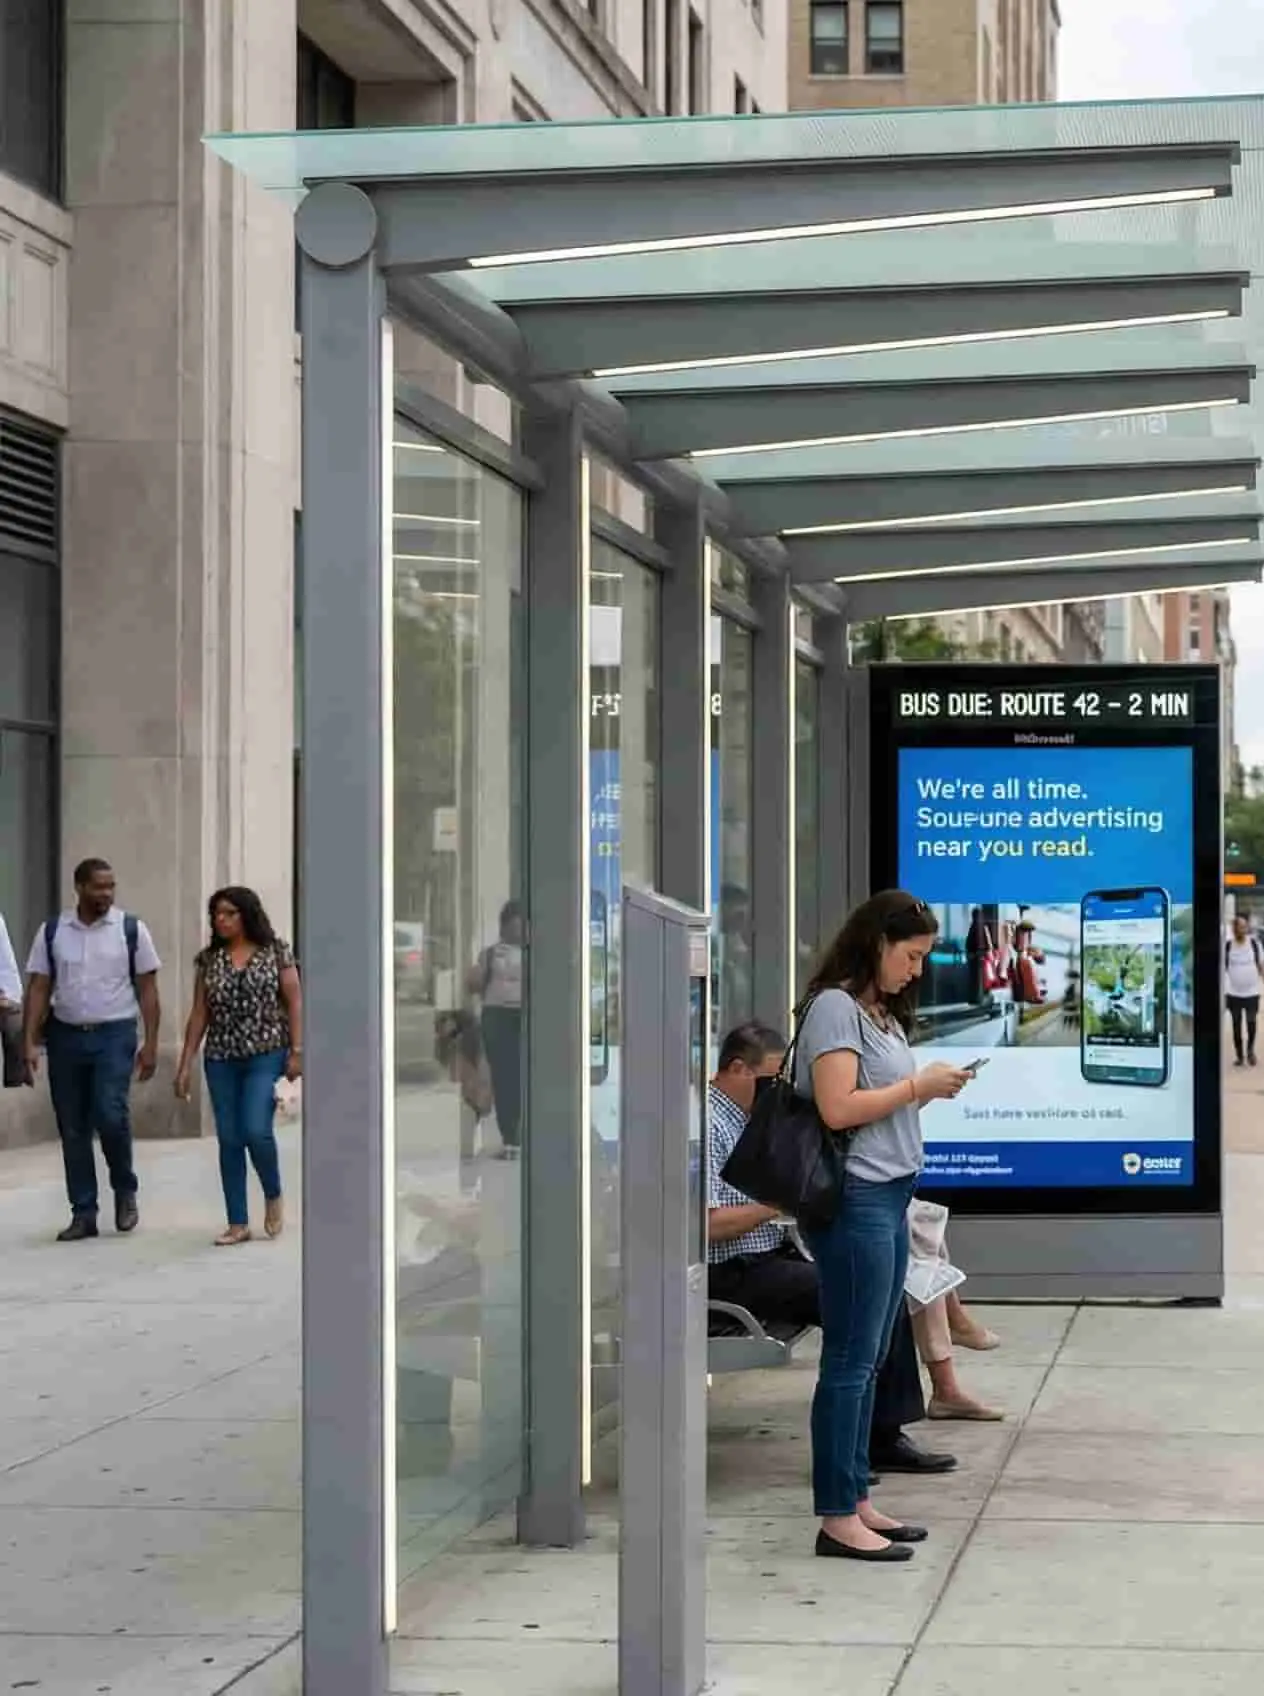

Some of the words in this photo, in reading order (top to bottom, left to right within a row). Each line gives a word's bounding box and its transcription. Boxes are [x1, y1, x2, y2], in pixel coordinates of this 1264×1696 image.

[900, 692, 940, 716] BUS
[948, 692, 993, 716] DUE:
[1000, 692, 1067, 716] ROUTE
[1072, 692, 1101, 717] 42
[1128, 692, 1143, 716] 2
[1151, 692, 1189, 717] MIN
[917, 777, 985, 800] We're
[991, 777, 1020, 800] all
[1027, 777, 1088, 800] time.
[1028, 805, 1164, 834] advertising
[917, 840, 972, 857] near
[978, 840, 1024, 862] you
[1031, 835, 1094, 857] read.
